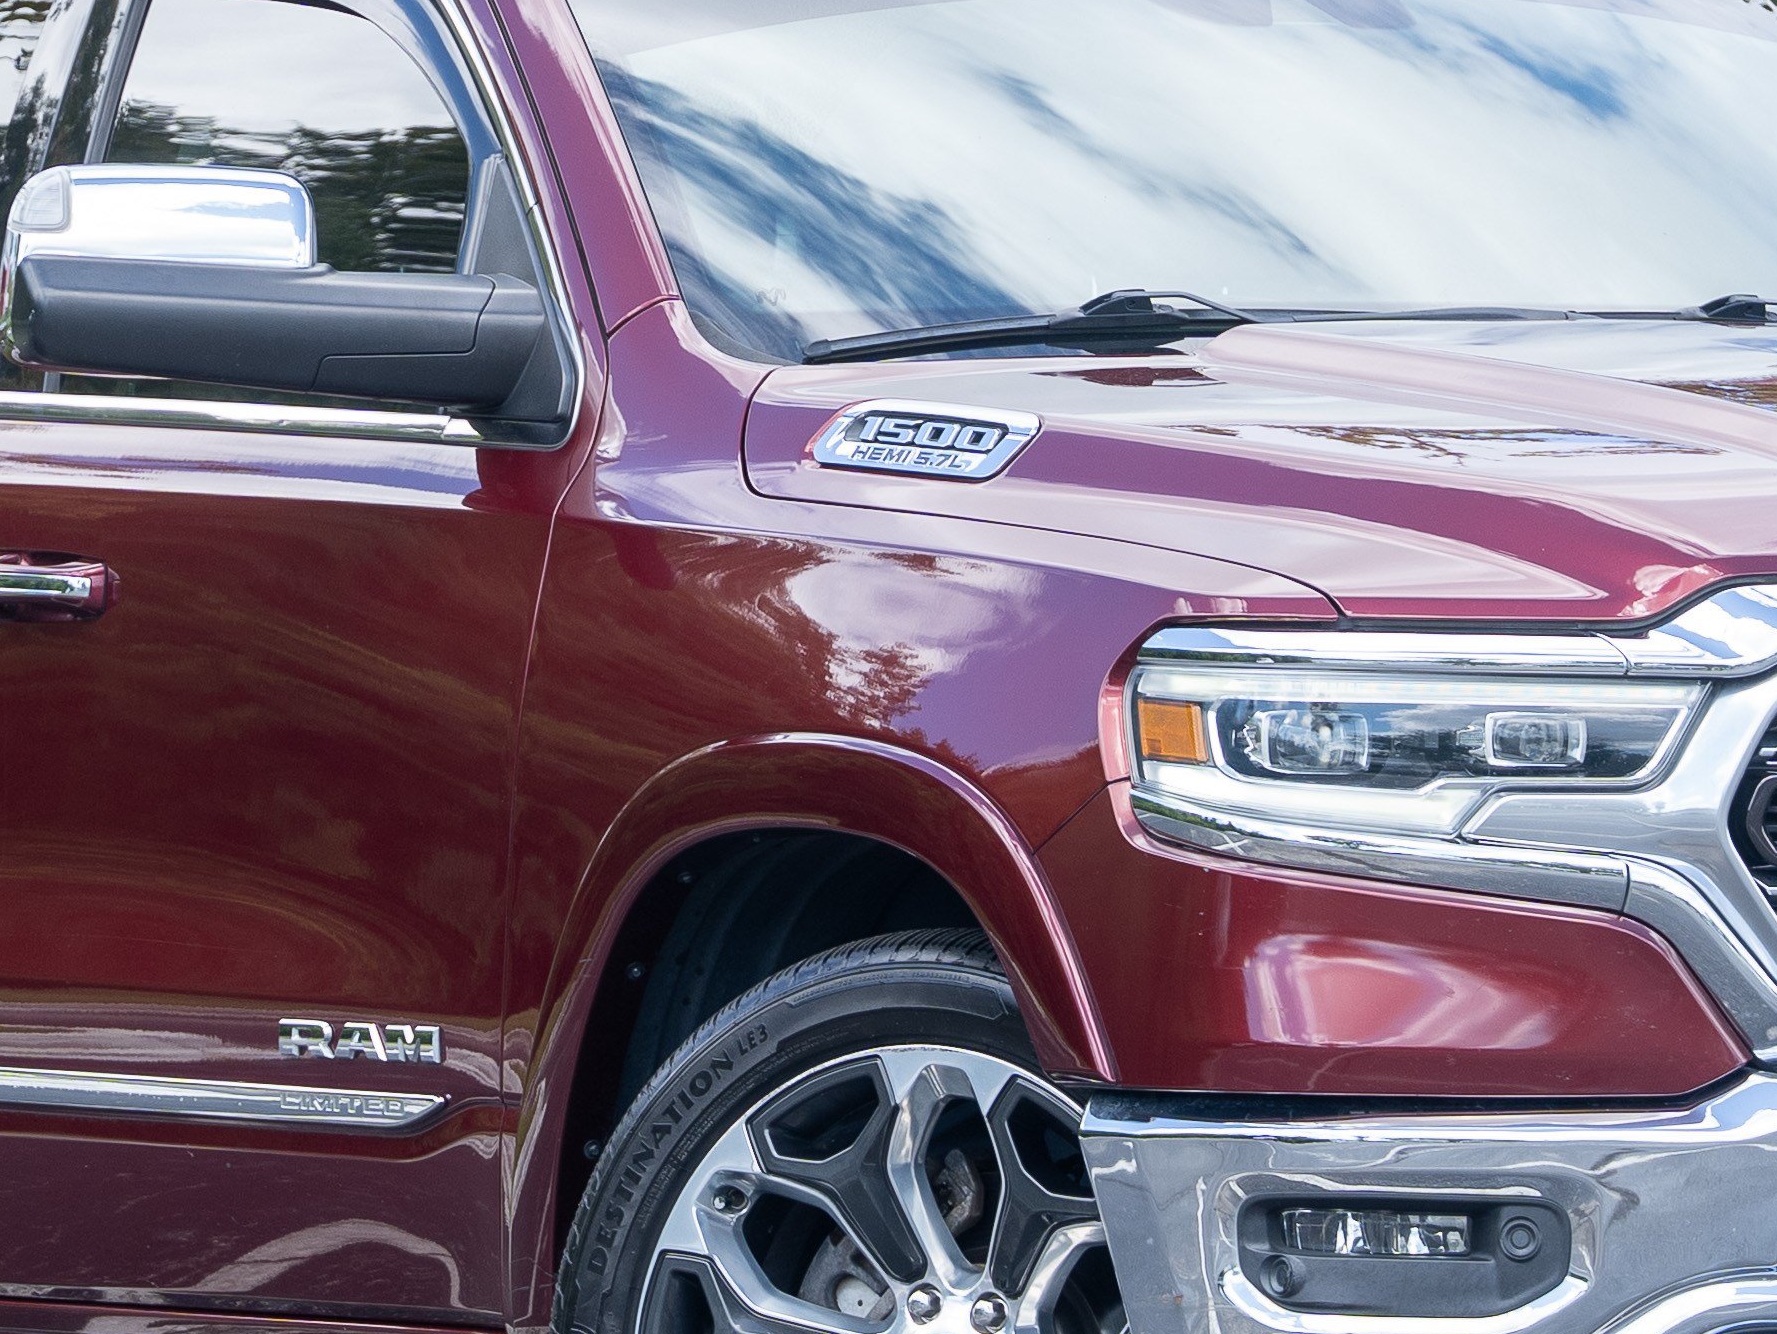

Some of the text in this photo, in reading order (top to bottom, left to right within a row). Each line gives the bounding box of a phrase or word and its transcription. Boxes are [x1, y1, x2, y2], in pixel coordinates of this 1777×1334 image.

[860, 415, 1002, 452] 1500
[851, 446, 966, 470] HEMI 5.7L
[278, 1017, 445, 1064] RAM
[279, 1092, 406, 1117] LIMITED
[586, 1050, 735, 1277] DESTINATION
[737, 1022, 770, 1057] LE3
